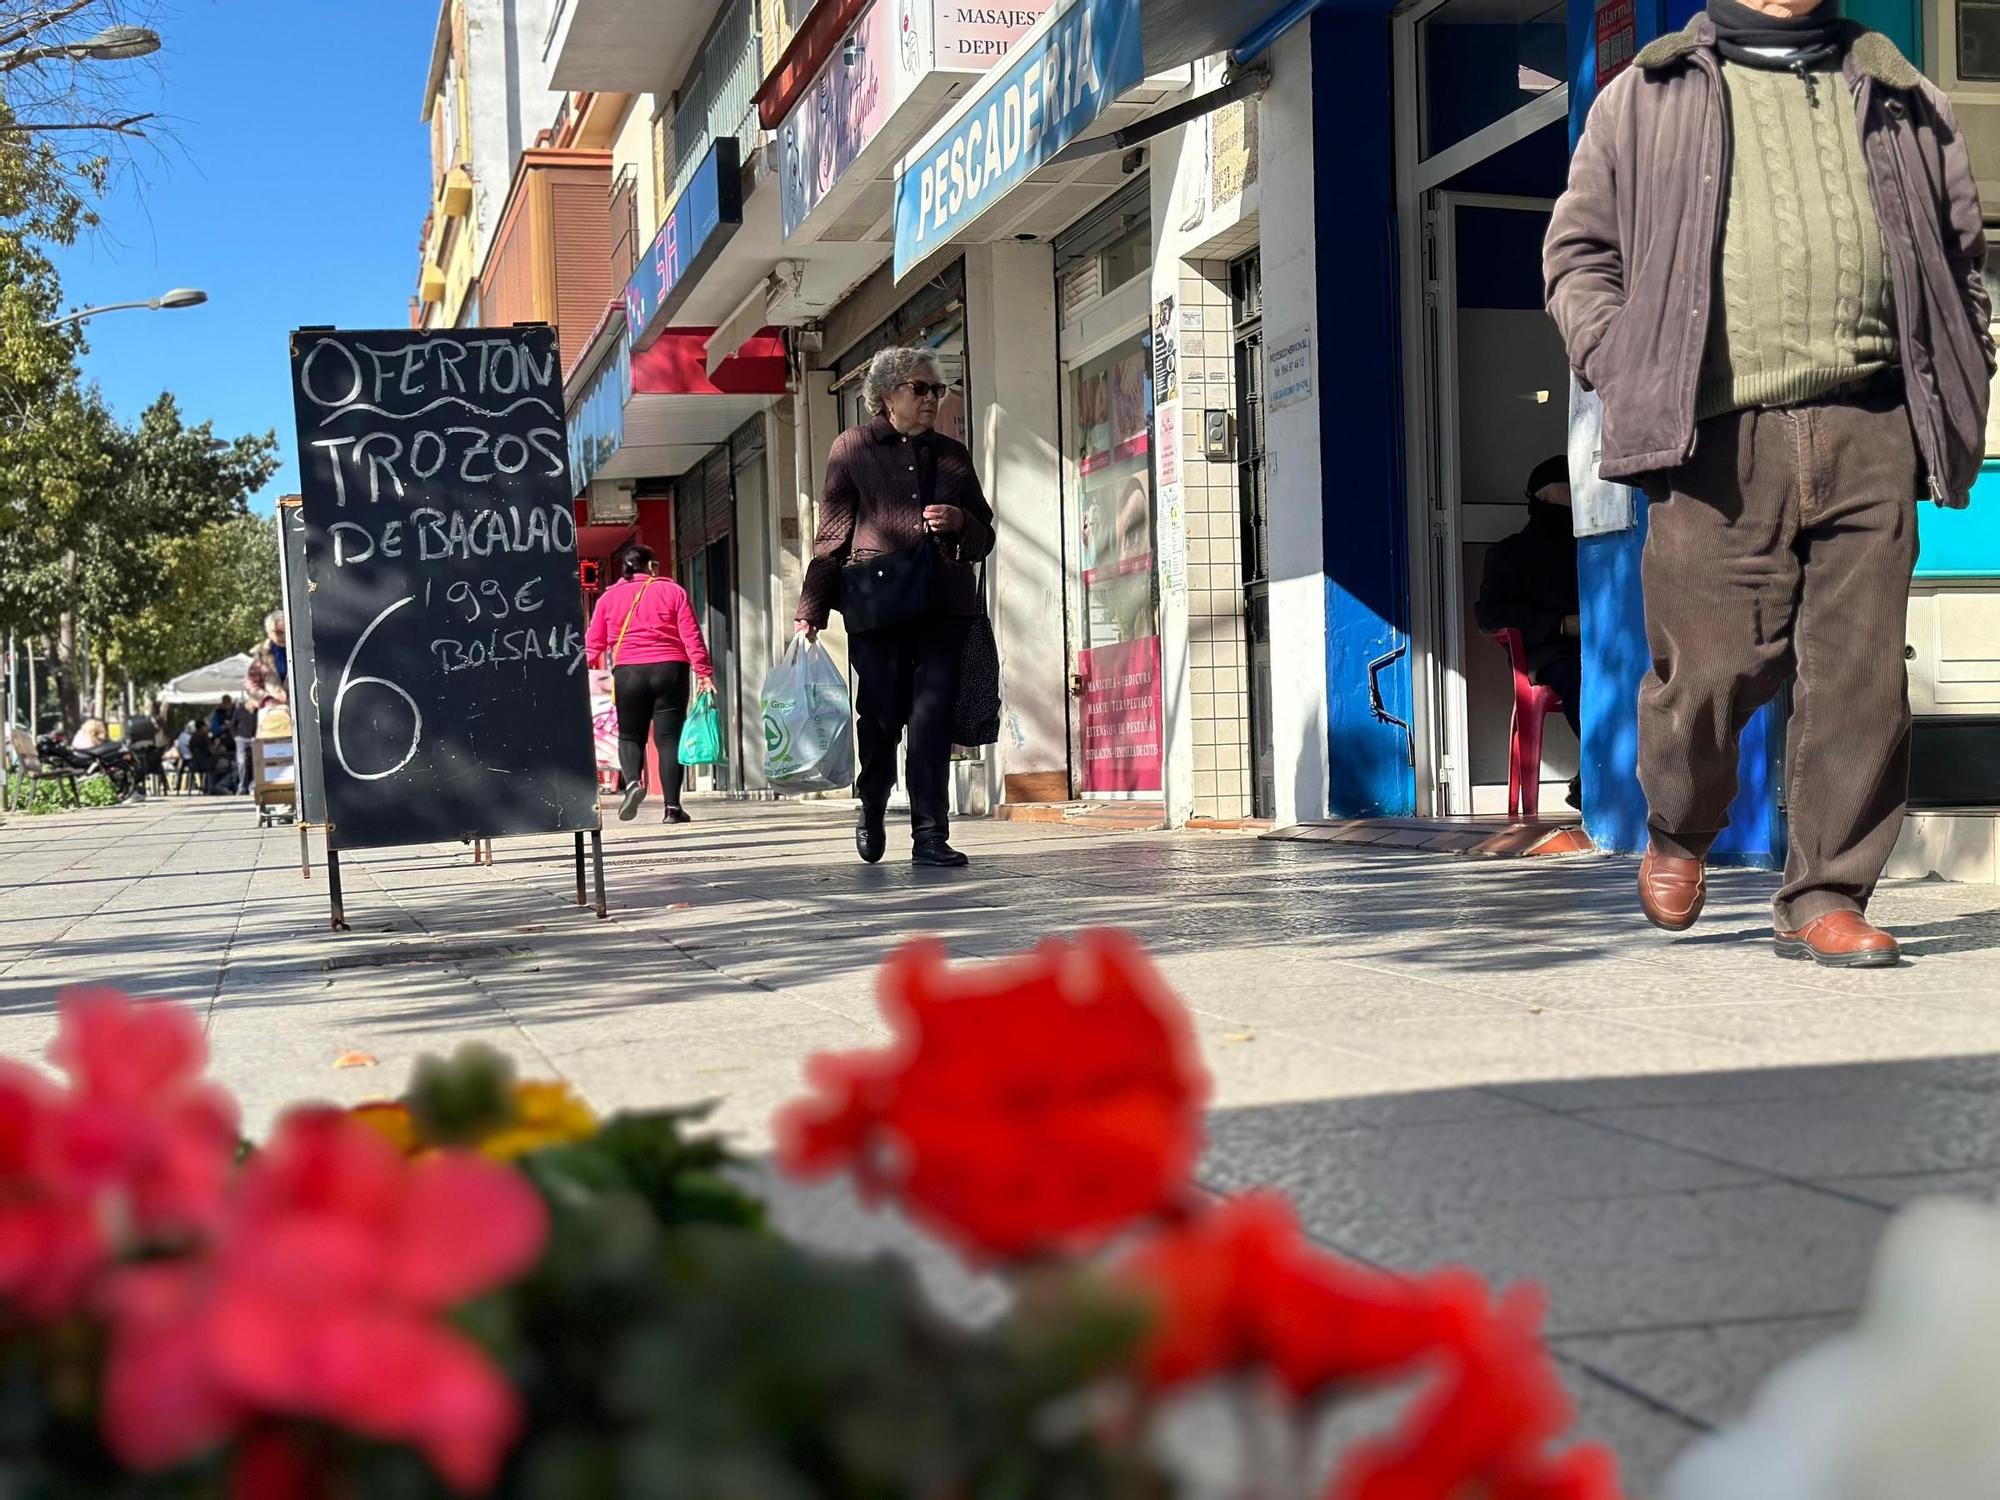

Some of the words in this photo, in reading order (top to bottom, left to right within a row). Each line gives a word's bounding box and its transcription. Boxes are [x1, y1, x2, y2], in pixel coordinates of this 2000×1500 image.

[957, 9, 1036, 28] MASAJES
[916, 8, 1100, 241] PESCADERIA
[311, 427, 563, 506] TROZOS
[328, 521, 402, 567] DE
[410, 504, 574, 560] BACALAO
